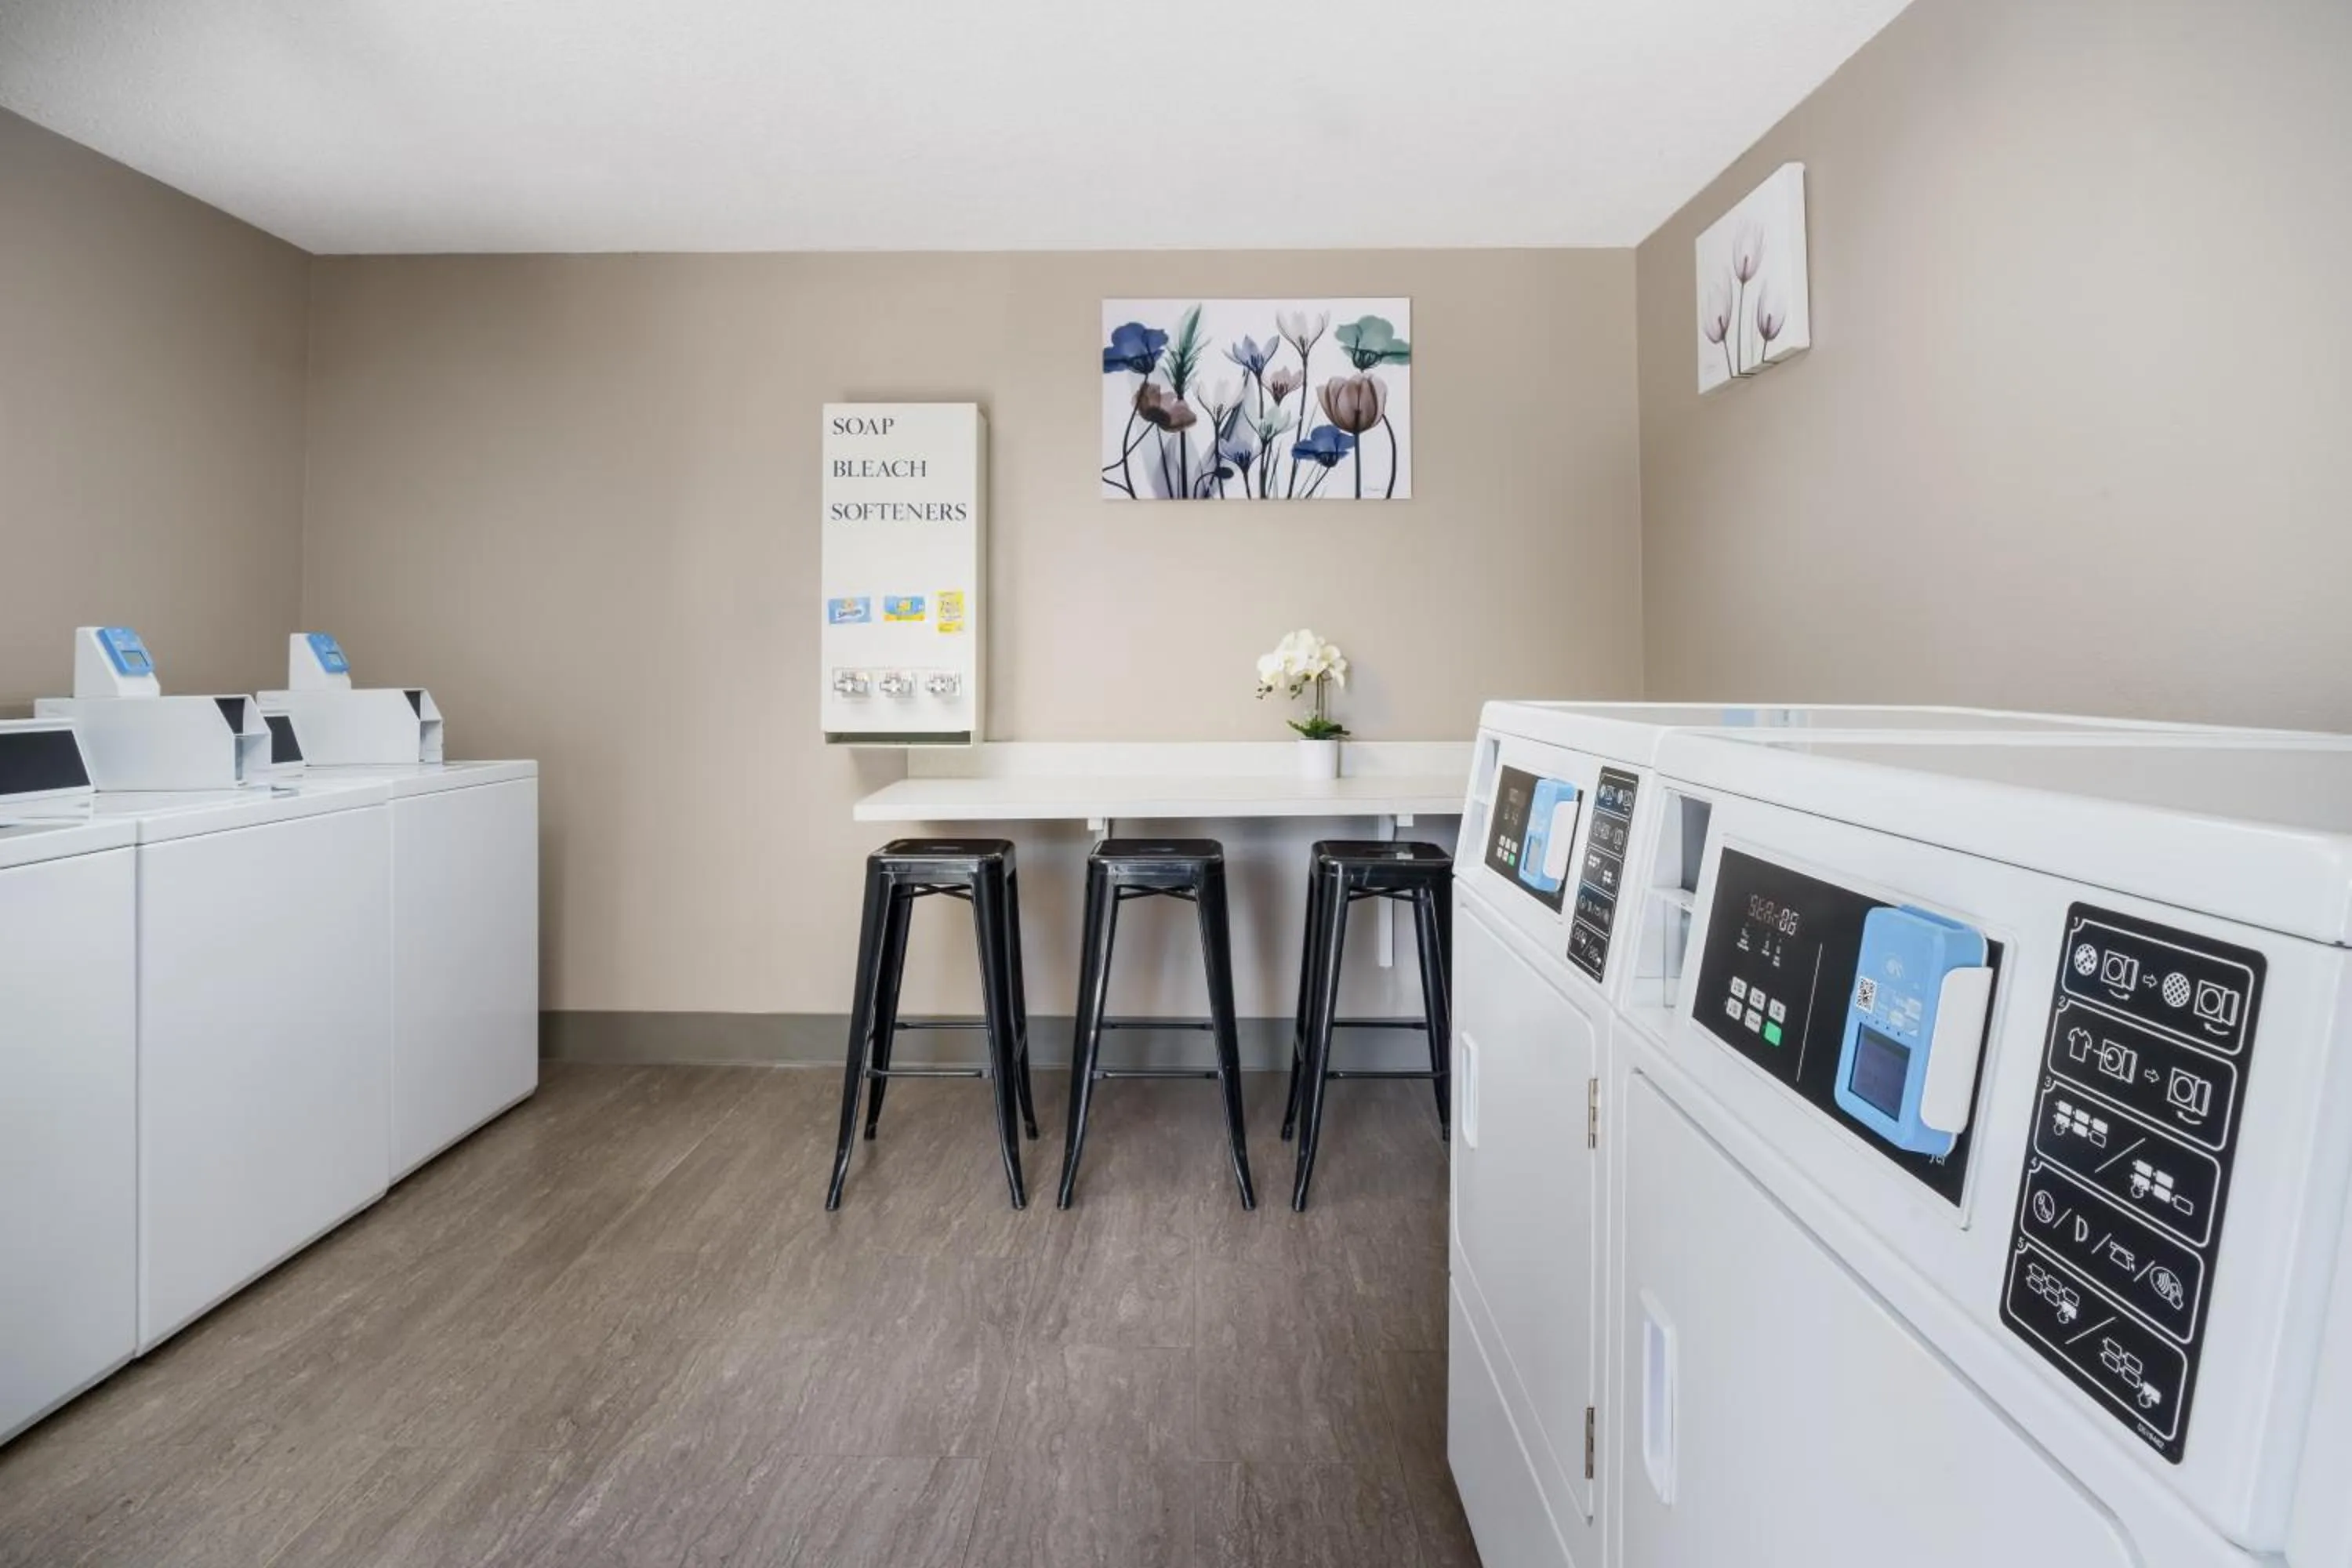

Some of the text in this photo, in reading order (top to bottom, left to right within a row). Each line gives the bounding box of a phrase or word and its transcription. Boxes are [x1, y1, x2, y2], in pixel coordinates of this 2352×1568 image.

[833, 418, 895, 435] SOAP
[833, 459, 927, 477] BLEACH
[831, 503, 967, 521] SOFTENERS
[2058, 995, 2066, 1007] 2
[2044, 1075, 2052, 1087] 3
[2017, 1236, 2024, 1249] 5
